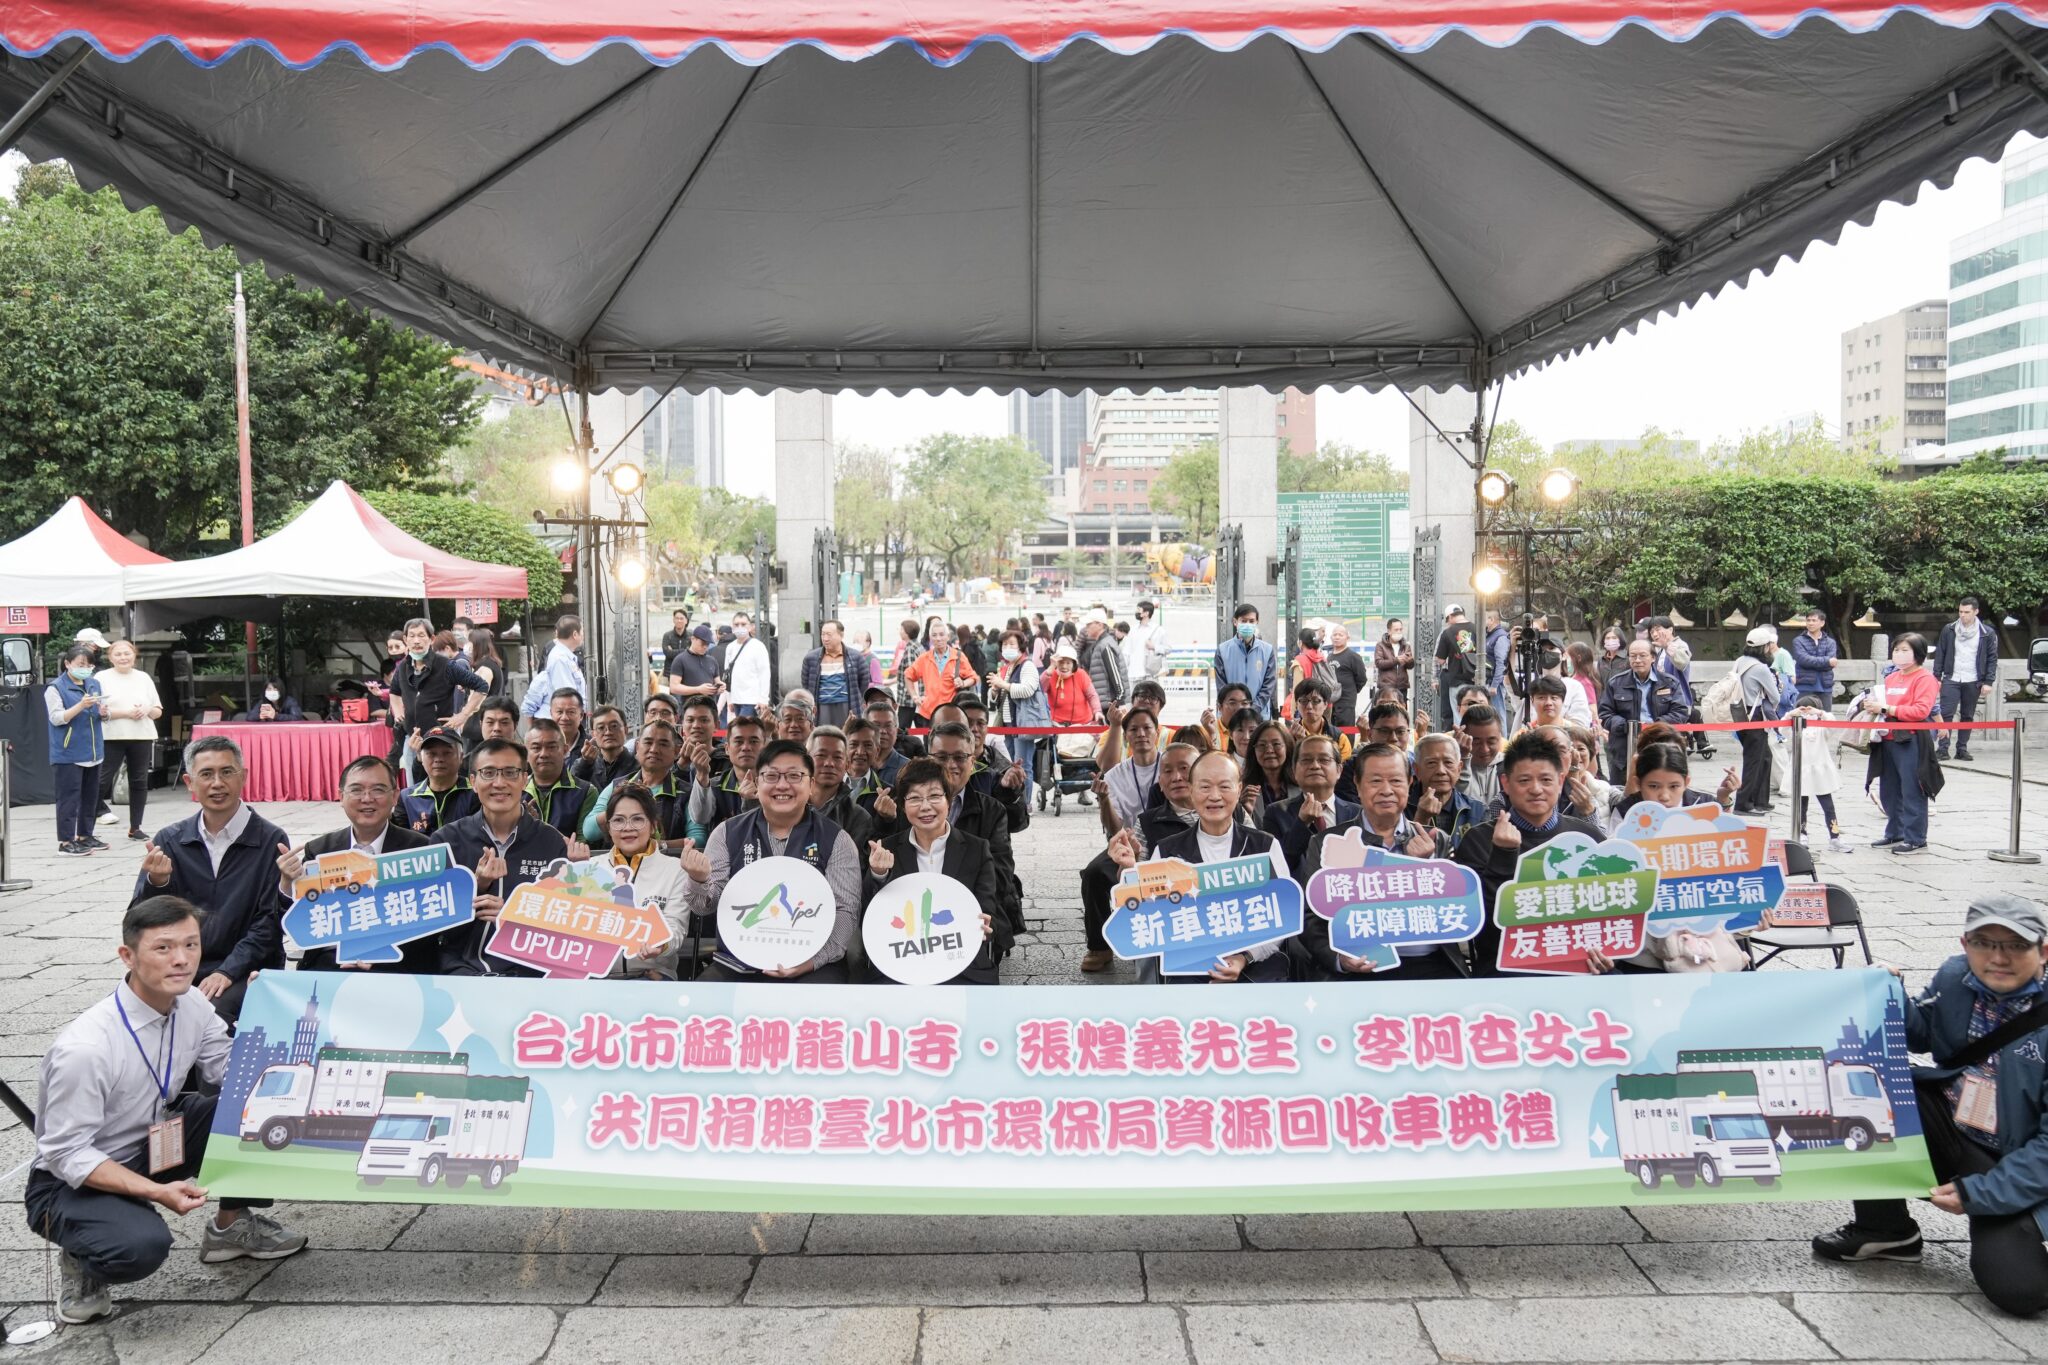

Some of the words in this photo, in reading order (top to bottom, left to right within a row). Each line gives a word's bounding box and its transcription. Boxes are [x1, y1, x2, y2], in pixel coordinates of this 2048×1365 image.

[8, 607, 28, 625] 區
[381, 853, 441, 880] NEW!
[1203, 862, 1265, 890] NEW!
[1324, 867, 1446, 903] 降低車齡
[309, 881, 456, 940] 新車報到
[514, 891, 653, 943] 環保行動力
[1514, 878, 1639, 920] 愛護地球
[1129, 892, 1283, 949] 新車報到
[1346, 903, 1470, 939] 保障職安
[1509, 918, 1636, 960] 友善環境
[510, 927, 594, 967] UPUP!
[888, 931, 963, 959] TAIPEI
[589, 1090, 1557, 1150] 共同捐贈臺北市環保局資源回收車典禮
